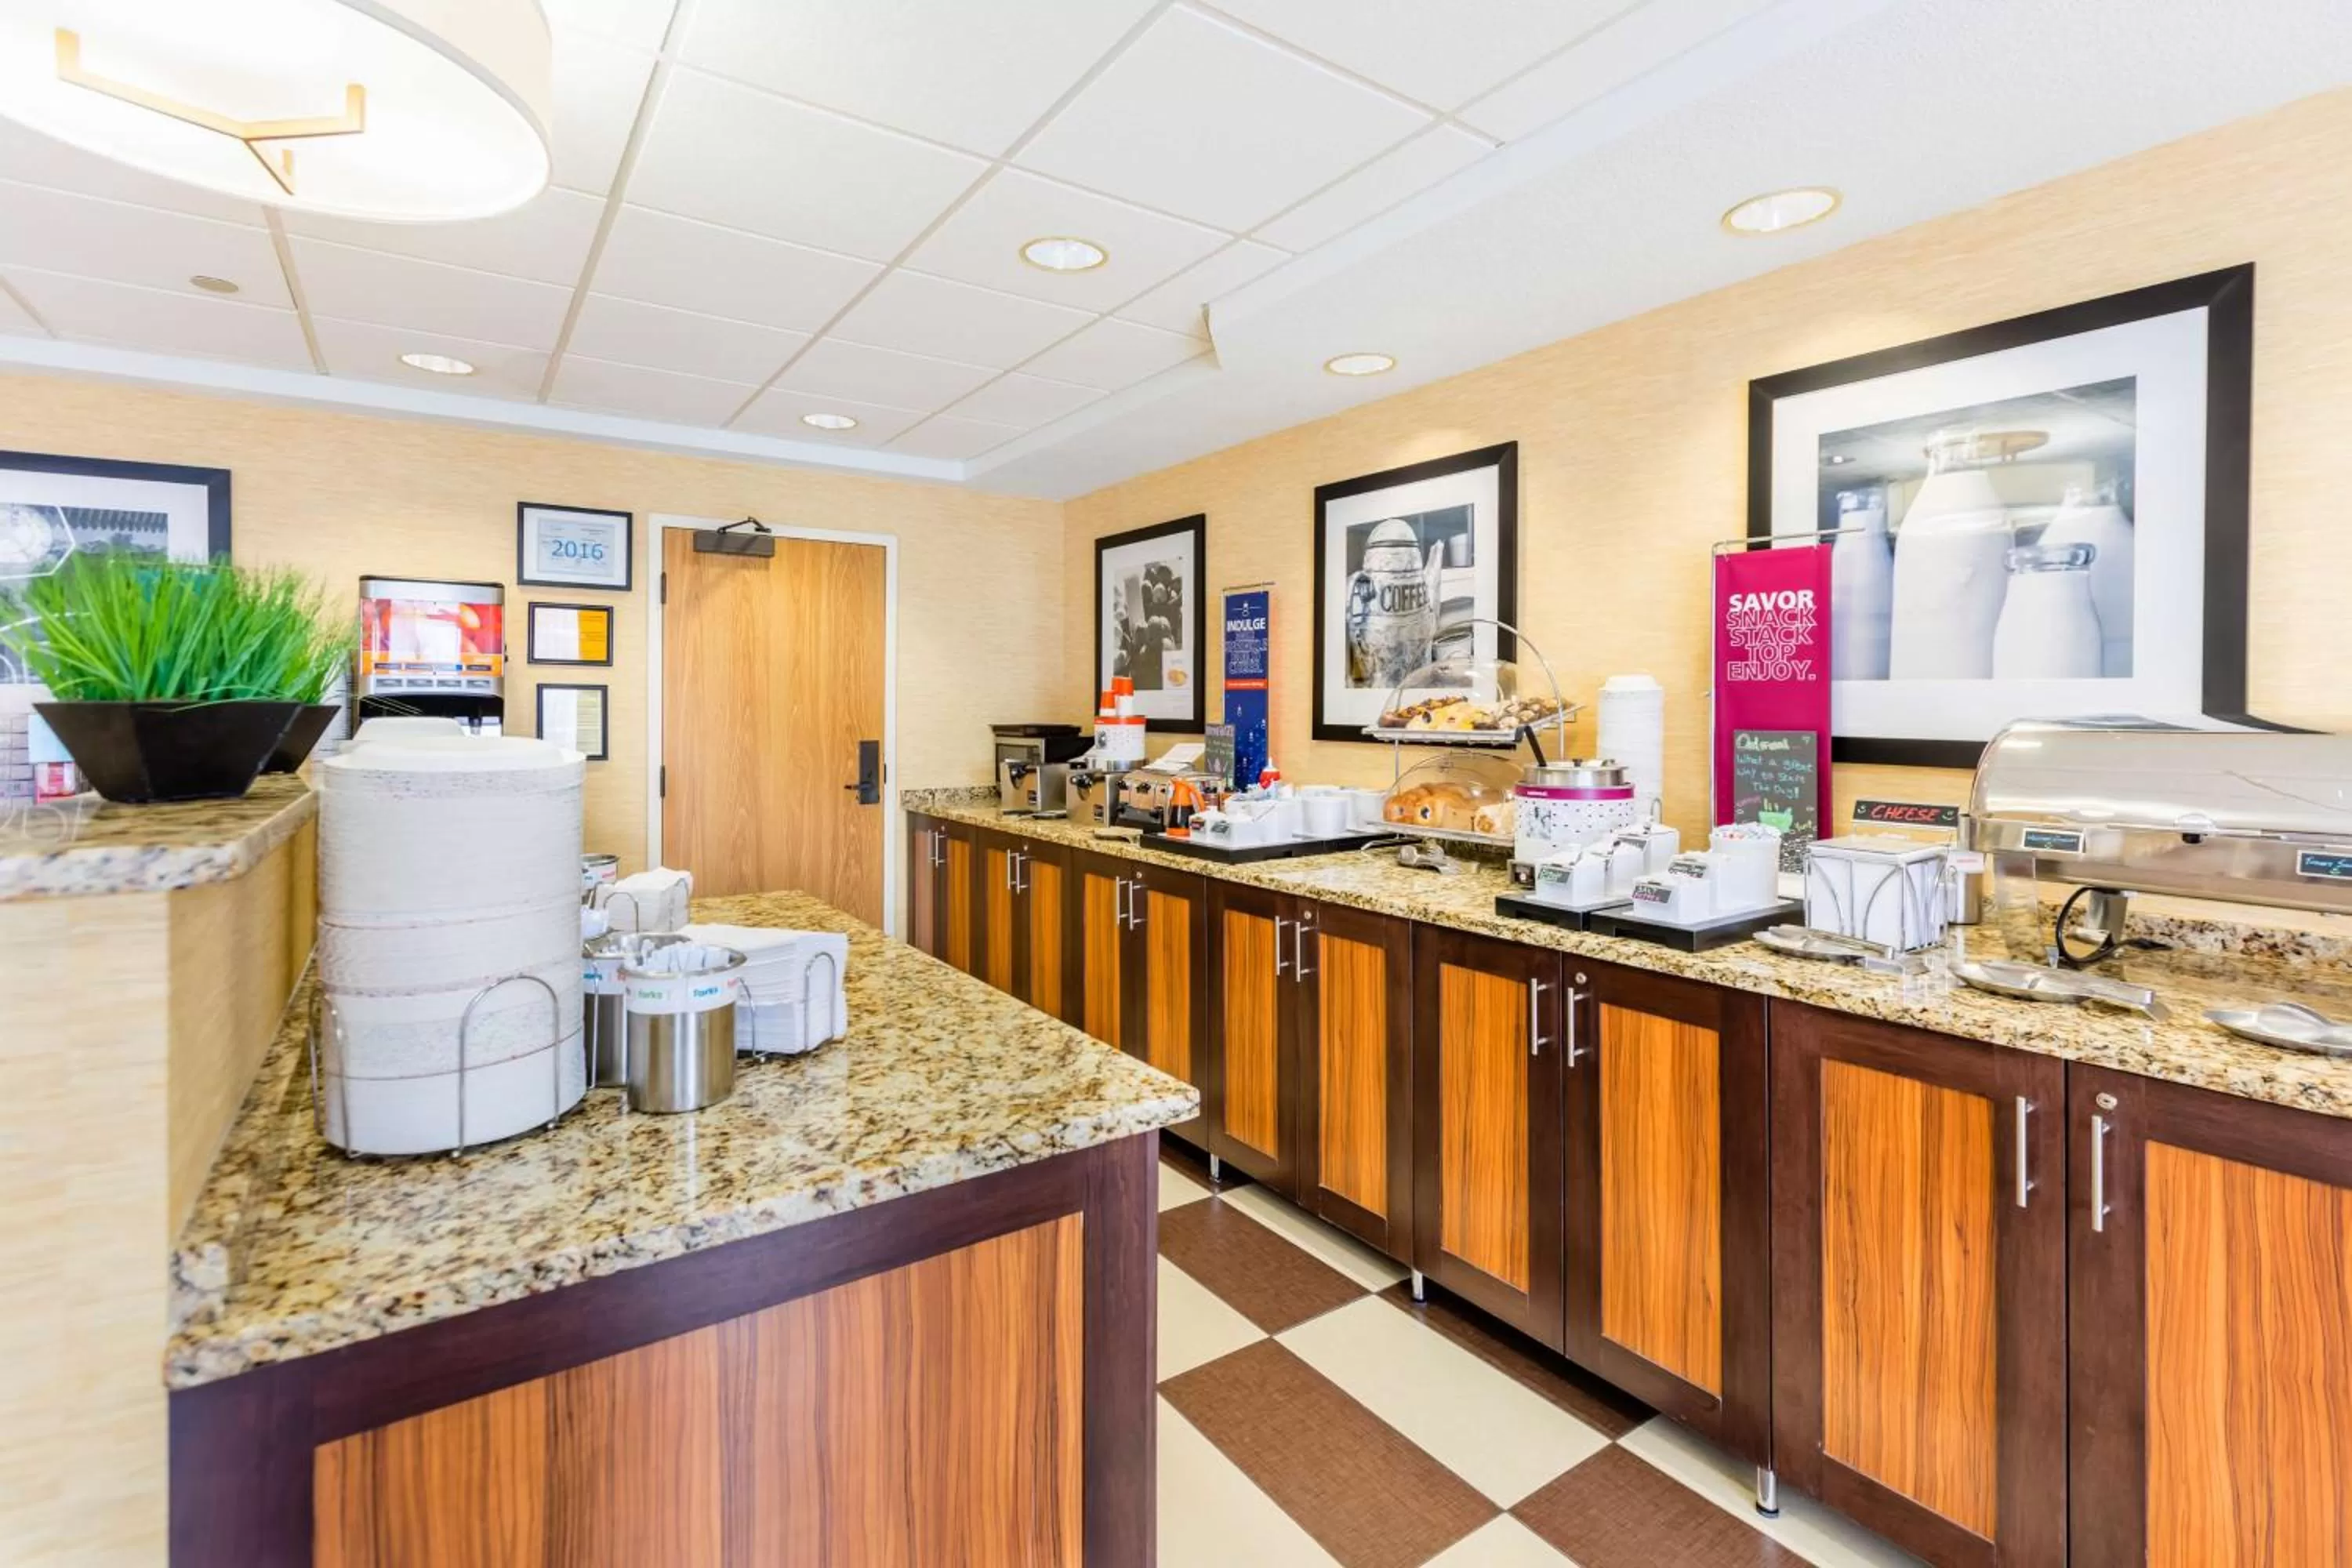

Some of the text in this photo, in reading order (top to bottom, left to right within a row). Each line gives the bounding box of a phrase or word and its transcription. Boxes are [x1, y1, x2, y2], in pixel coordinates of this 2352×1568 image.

[551, 539, 603, 561] 2016
[1380, 581, 1428, 612] COFFEE
[1729, 590, 1814, 612] SAVOR
[1227, 617, 1266, 632] INDULGE
[1726, 605, 1817, 629] SNACK
[1730, 626, 1814, 646] STACK
[1744, 643, 1796, 663] TOP
[1727, 659, 1817, 681] ENJOY.
[1871, 804, 1940, 822] CHEESE
